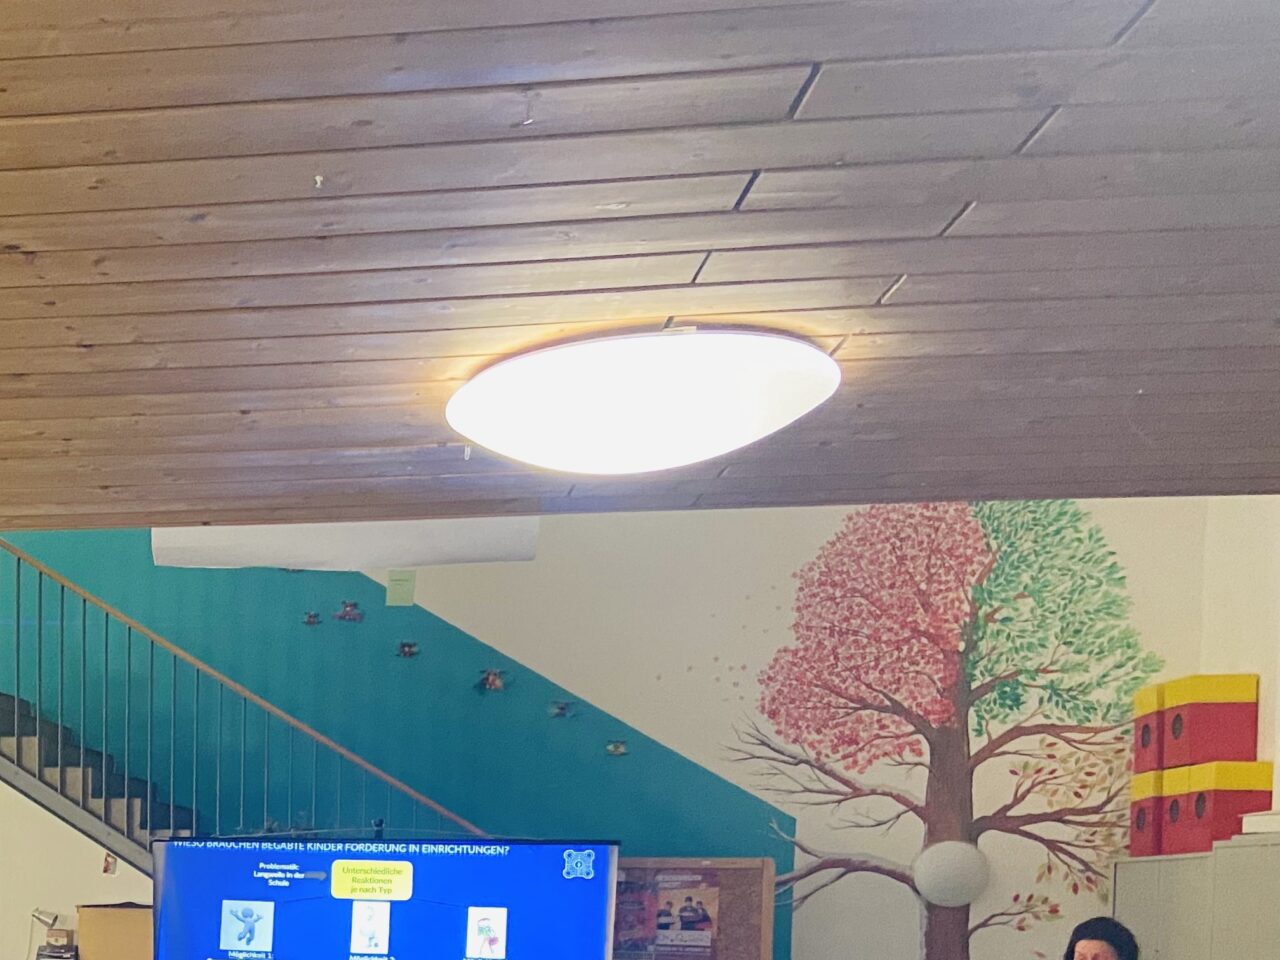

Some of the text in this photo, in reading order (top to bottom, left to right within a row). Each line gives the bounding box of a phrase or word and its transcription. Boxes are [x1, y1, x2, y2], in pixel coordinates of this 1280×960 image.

[206, 841, 259, 849] BRAUCHEN
[261, 842, 305, 850] BEGABTE
[306, 842, 343, 851] KINDER
[408, 844, 420, 853] IN
[422, 844, 510, 855] EINRICHTUNGEN?
[342, 866, 403, 875] Unterschiedliche
[268, 879, 290, 887] Schule
[352, 877, 393, 885] Reaktionen
[379, 887, 393, 895] Typ
